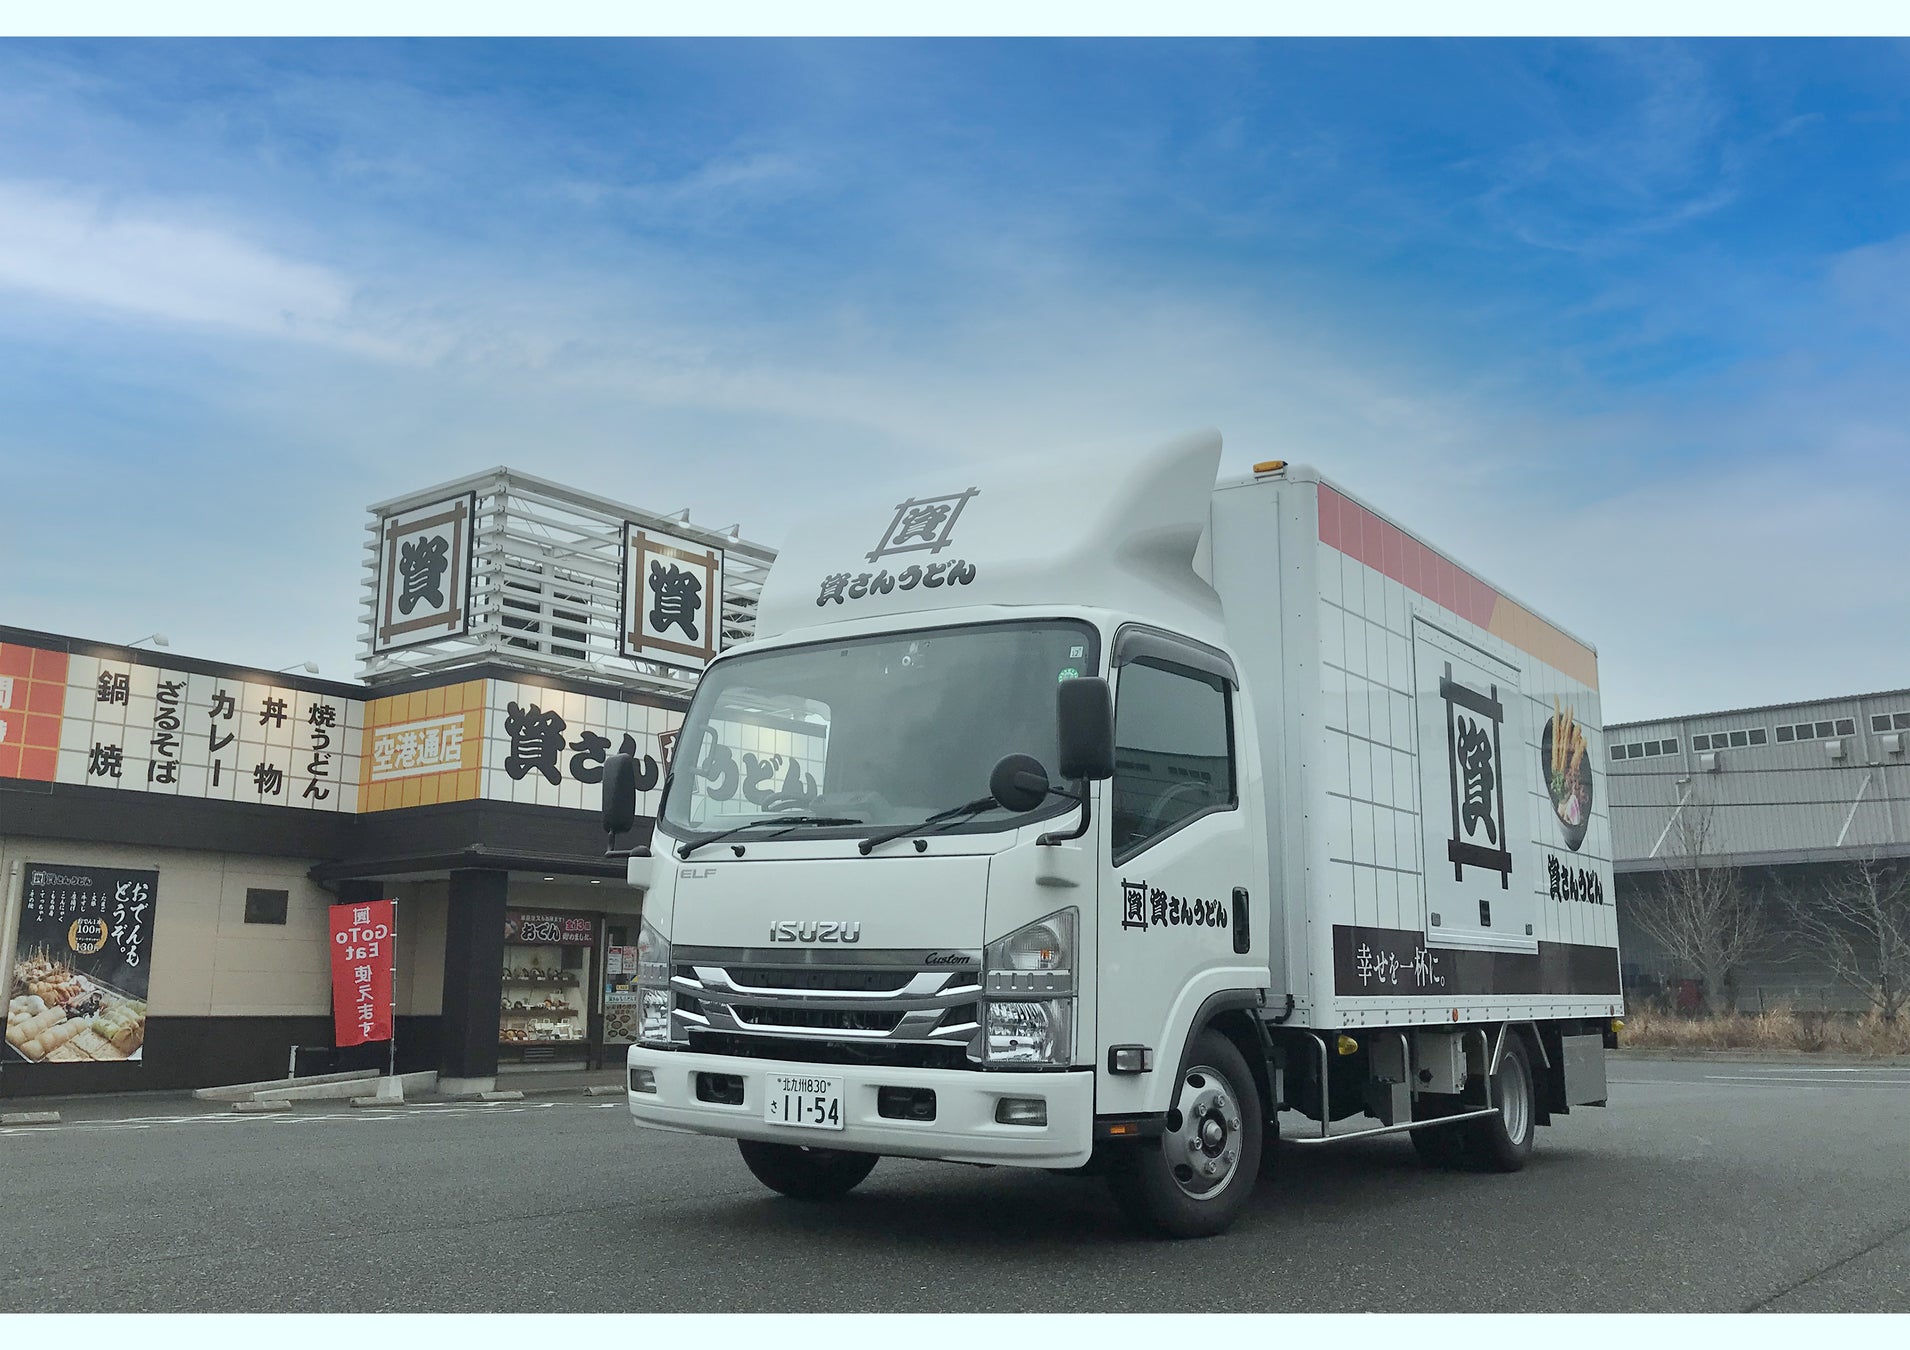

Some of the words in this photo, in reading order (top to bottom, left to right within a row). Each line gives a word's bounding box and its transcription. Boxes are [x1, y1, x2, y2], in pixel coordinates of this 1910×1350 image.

[893, 504, 951, 545] 資
[398, 536, 449, 615] 資
[648, 559, 702, 641] 資
[816, 559, 976, 607] 資さんうどん
[88, 670, 130, 778] 鍋焼
[148, 680, 187, 785] ざるそば
[208, 689, 236, 787] カレー
[253, 696, 288, 796] 丼物
[372, 725, 464, 772] 空港通店
[302, 703, 337, 800] 焼うどん
[1457, 714, 1496, 845] 資
[680, 868, 717, 879] ELF
[1548, 854, 1603, 905] 資さんうどん
[111, 881, 131, 953] どうぞ。
[126, 882, 149, 967] おでんも
[521, 922, 561, 942] おでん
[769, 920, 860, 943] ISUZU
[1150, 888, 1228, 928] 資さんうどん
[924, 952, 971, 966] Custom
[1357, 943, 1447, 987] 幸せを一杯に。
[771, 1100, 778, 1114] さ
[784, 1095, 839, 1126] 11-54
